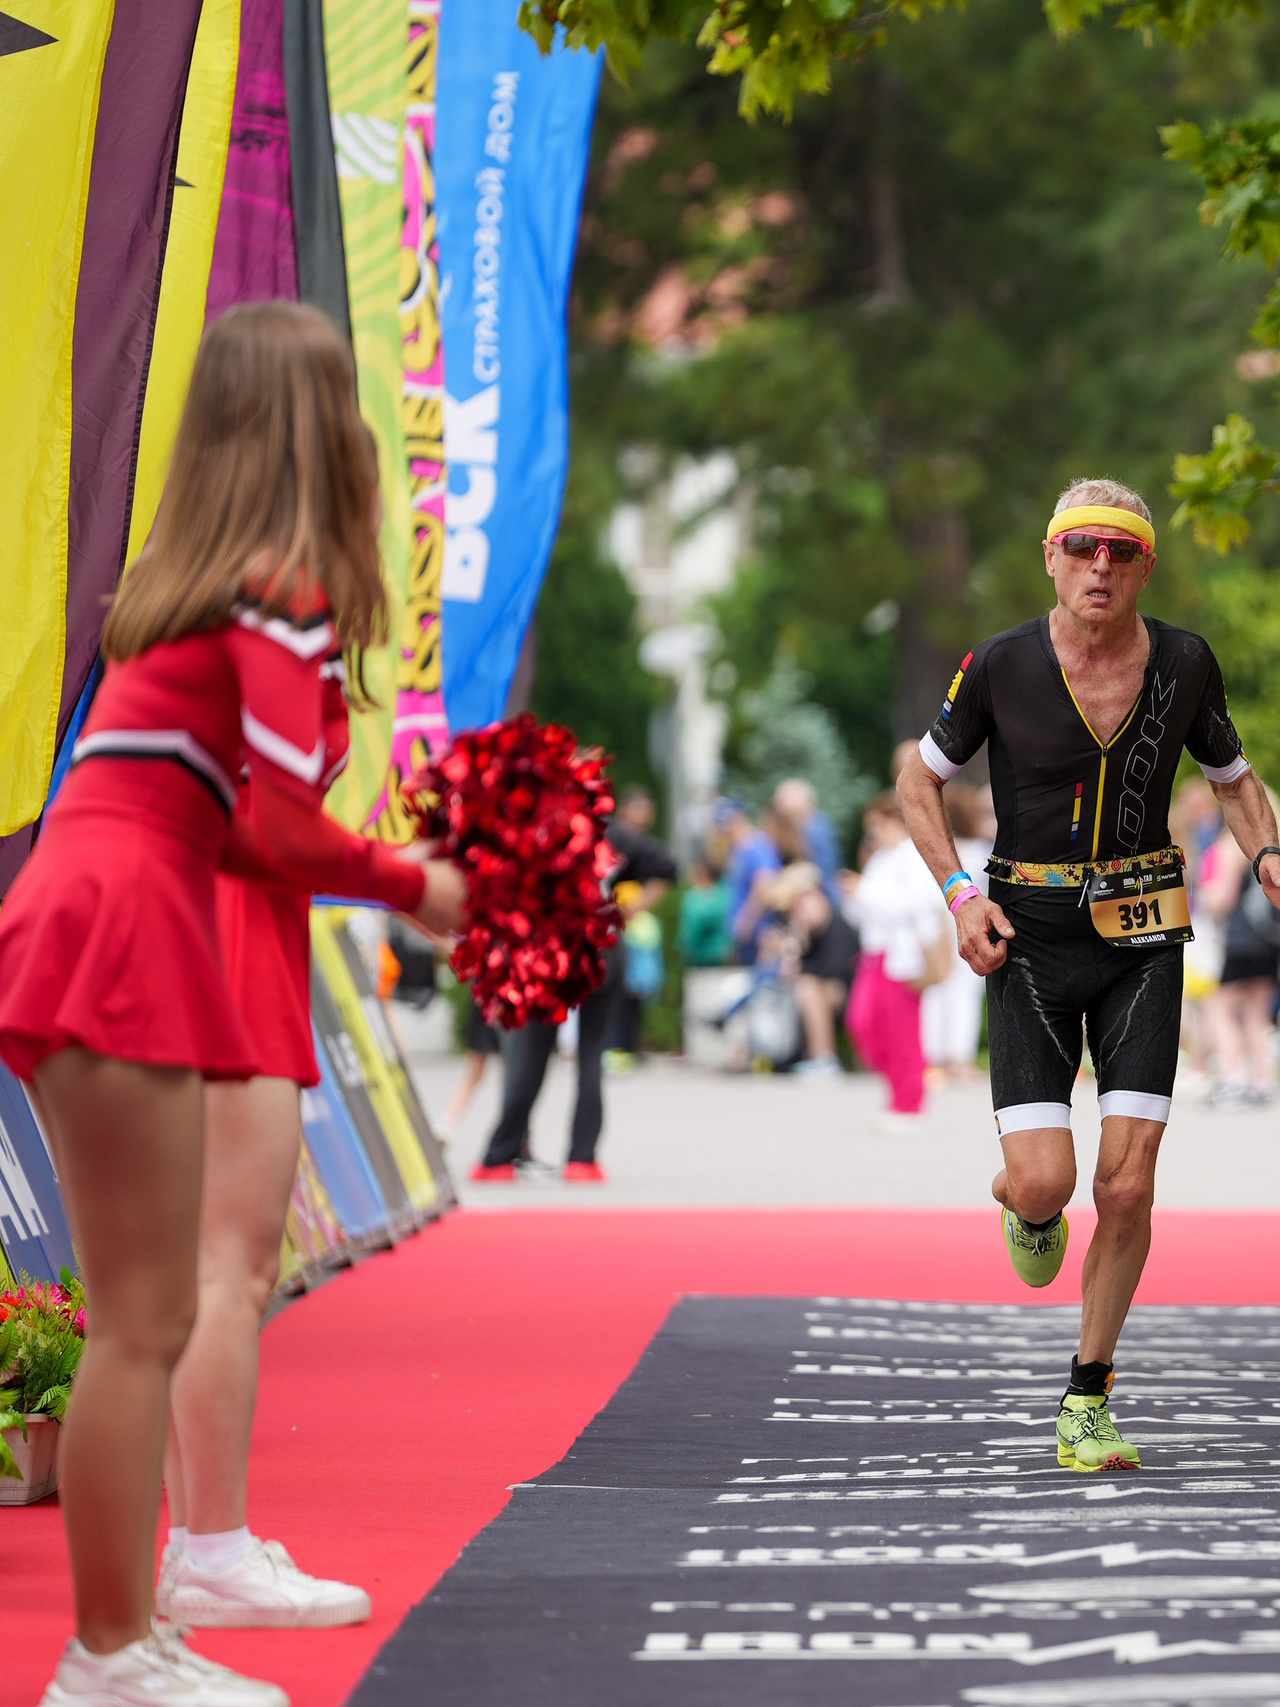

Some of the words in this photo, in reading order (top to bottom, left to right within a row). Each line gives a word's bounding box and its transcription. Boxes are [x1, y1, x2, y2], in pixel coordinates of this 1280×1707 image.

[484, 71, 520, 163] ДОМ
[472, 166, 506, 382] СТРАХОВОЙ
[442, 384, 499, 604] ВСК
[1122, 877, 1136, 887] IRON
[1118, 898, 1163, 931] 391
[1130, 933, 1167, 945] ALEKSANDR
[794, 1364, 1032, 1377] IRON
[772, 1411, 1031, 1421] IRON
[732, 1466, 1020, 1482] IRON
[716, 1486, 1017, 1502] IRON
[687, 1543, 1026, 1562] IRON
[644, 1632, 1033, 1652] IRON
